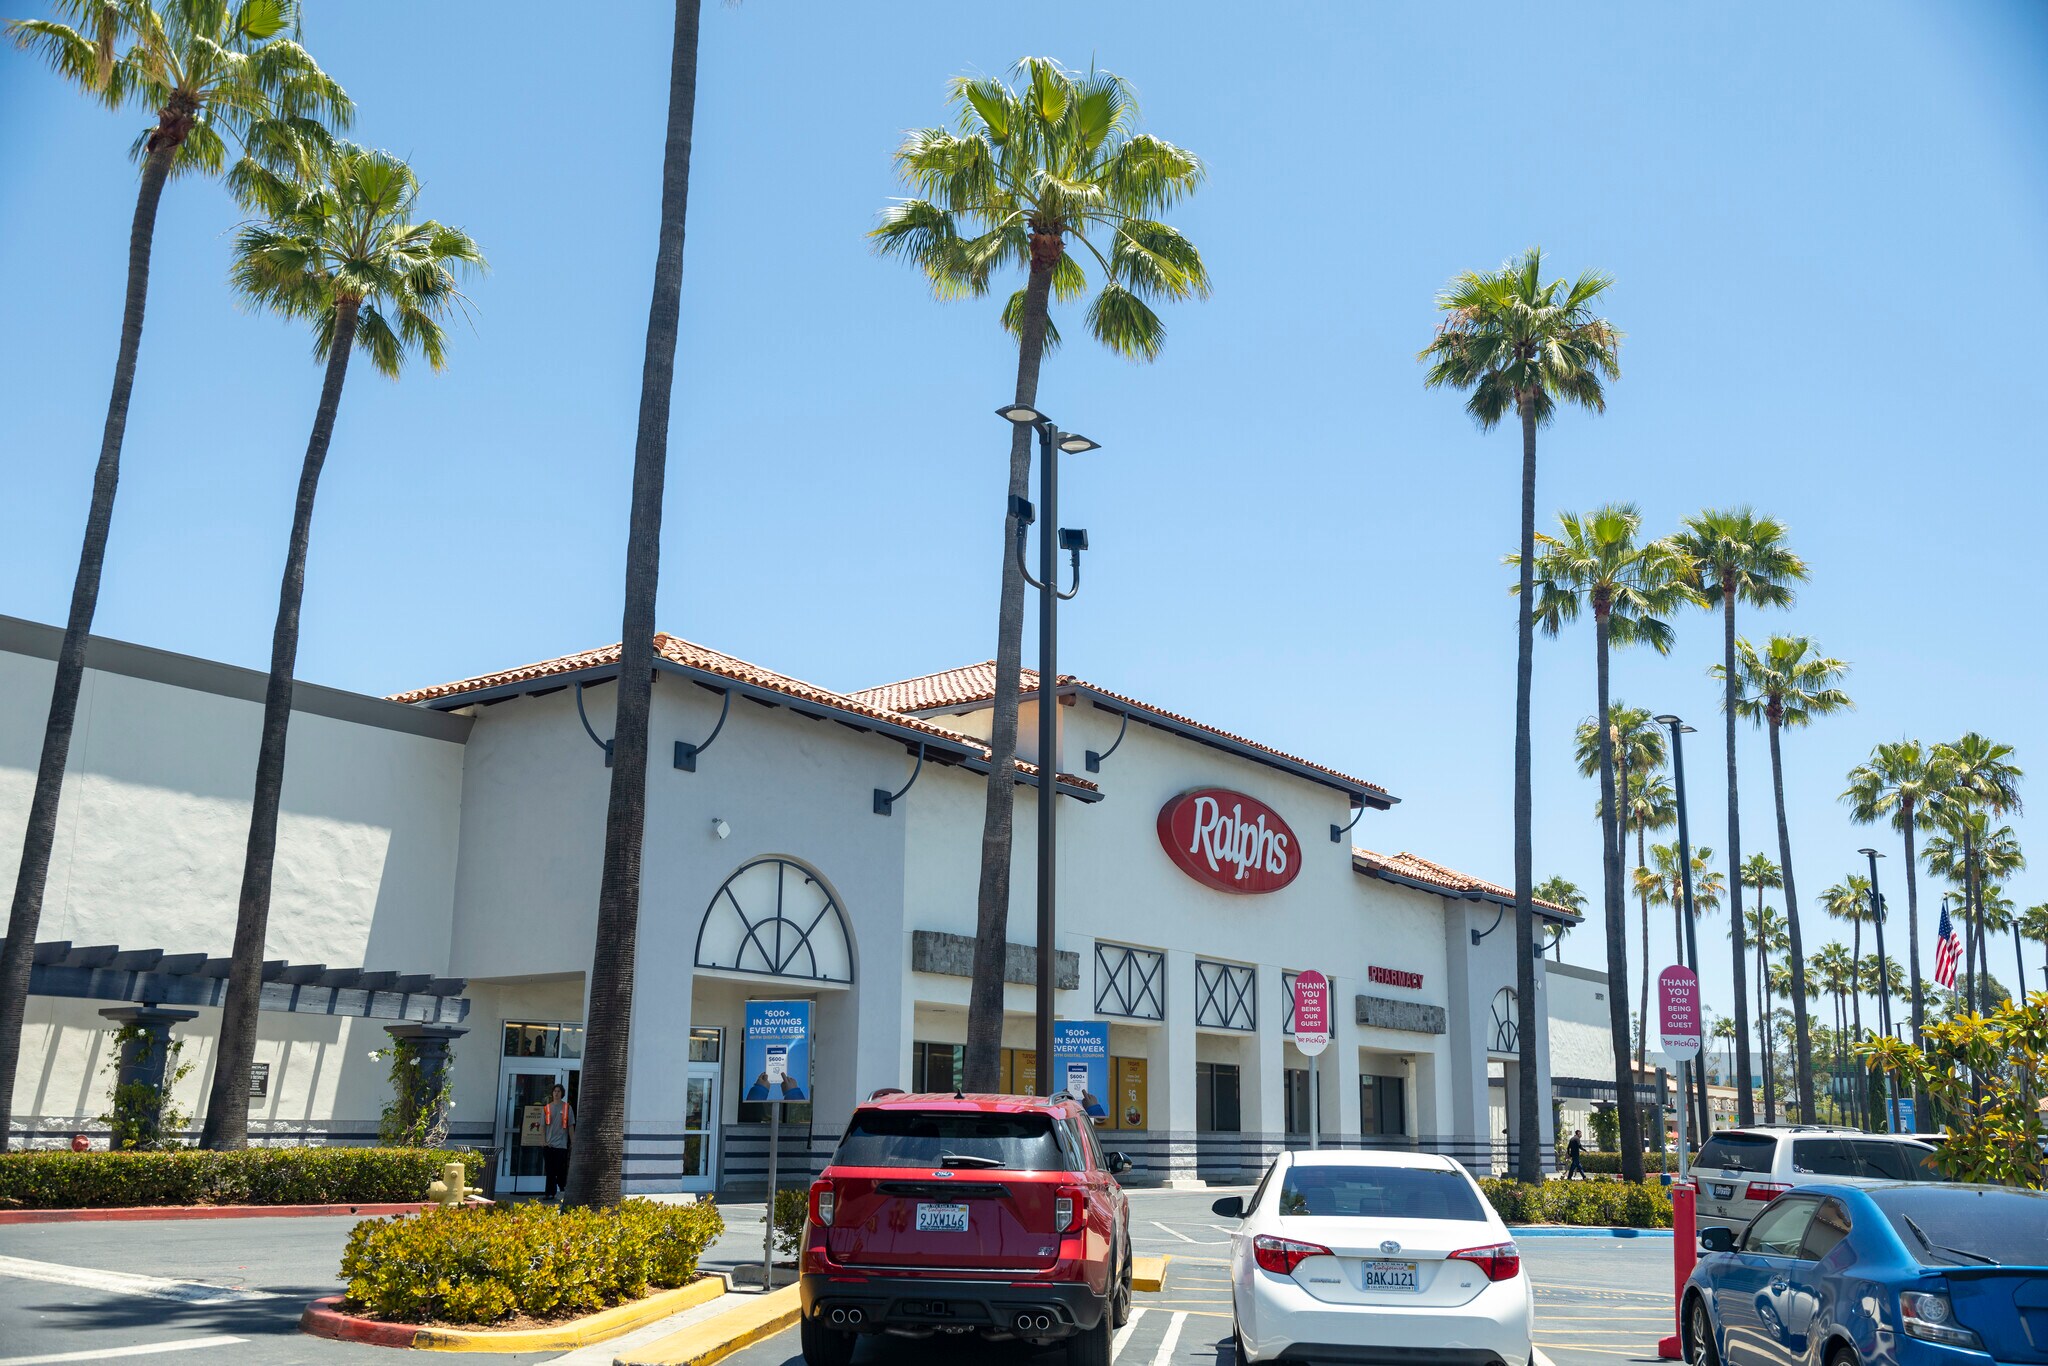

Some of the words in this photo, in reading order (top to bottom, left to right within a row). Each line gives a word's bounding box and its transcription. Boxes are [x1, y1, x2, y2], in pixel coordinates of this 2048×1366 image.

[1190, 797, 1287, 879] Ralphs
[1368, 966, 1424, 989] PHARMACY
[1297, 982, 1325, 990] THANK
[1661, 978, 1696, 987] THANK
[1668, 988, 1690, 996] YOU
[753, 1018, 762, 1026] IN
[764, 1018, 802, 1026] SAVINGS
[749, 1026, 777, 1034] EVERY
[780, 1026, 805, 1034] WEEK
[1065, 1037, 1102, 1045] SAVINGS
[1128, 1090, 1137, 1101] $6
[920, 1212, 964, 1227] 9JXW146
[1373, 1264, 1408, 1272] California
[1366, 1271, 1415, 1286] 8AKJ121
